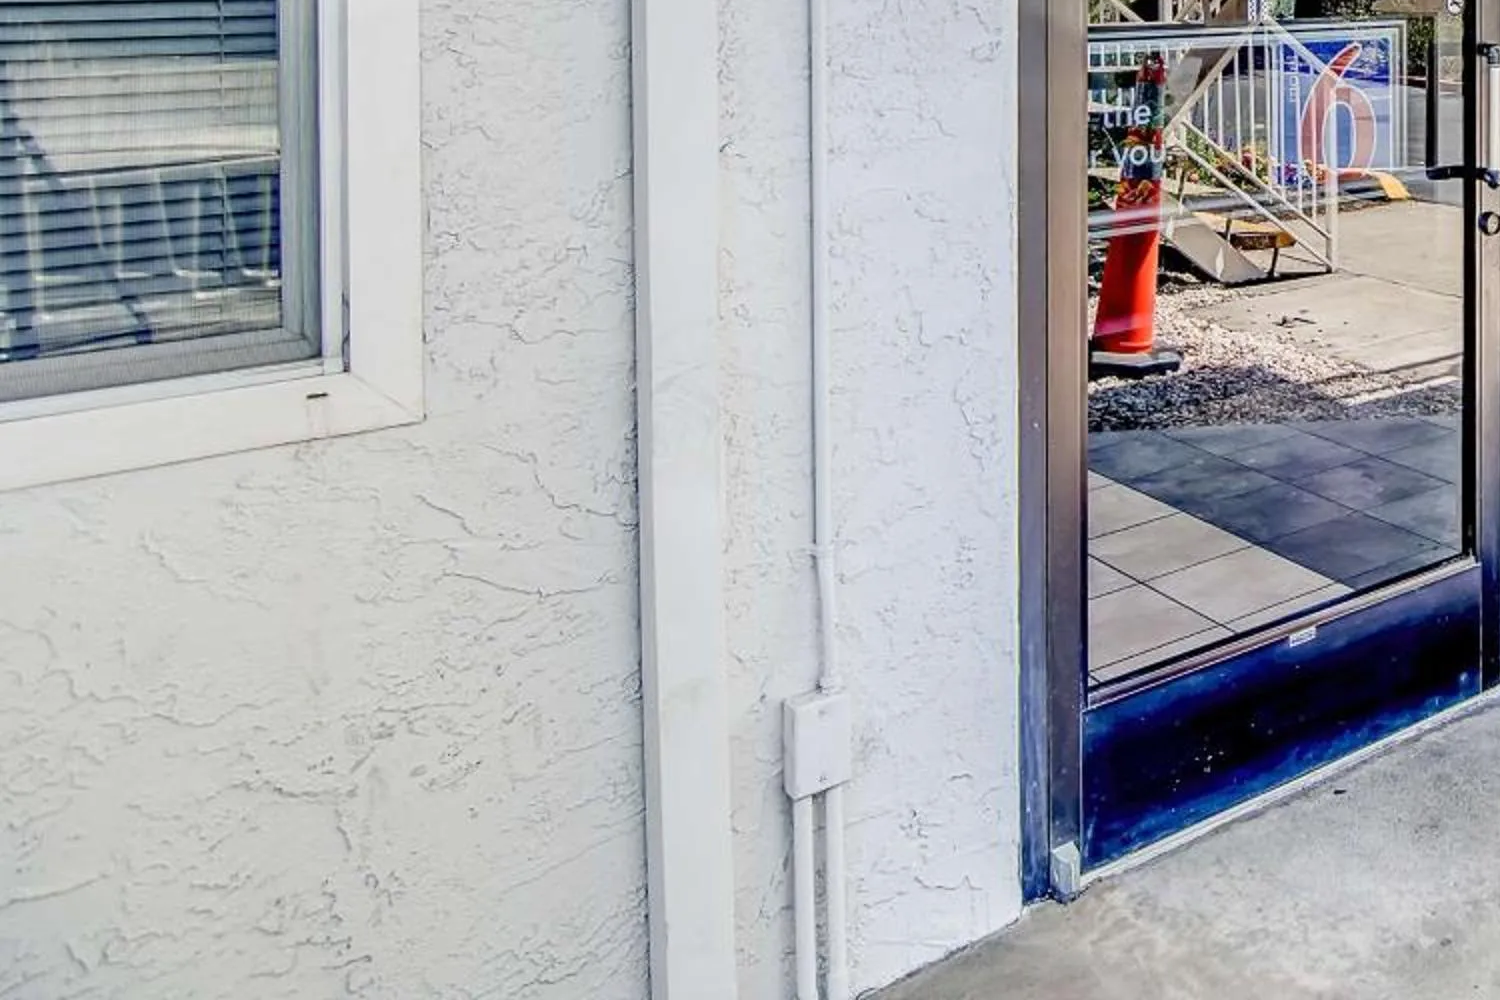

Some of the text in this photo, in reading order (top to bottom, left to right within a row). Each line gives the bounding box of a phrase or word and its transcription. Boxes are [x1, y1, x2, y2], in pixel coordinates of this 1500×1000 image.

[1102, 92, 1151, 127] the
[1300, 42, 1377, 179] 6
[1112, 144, 1166, 175] you
